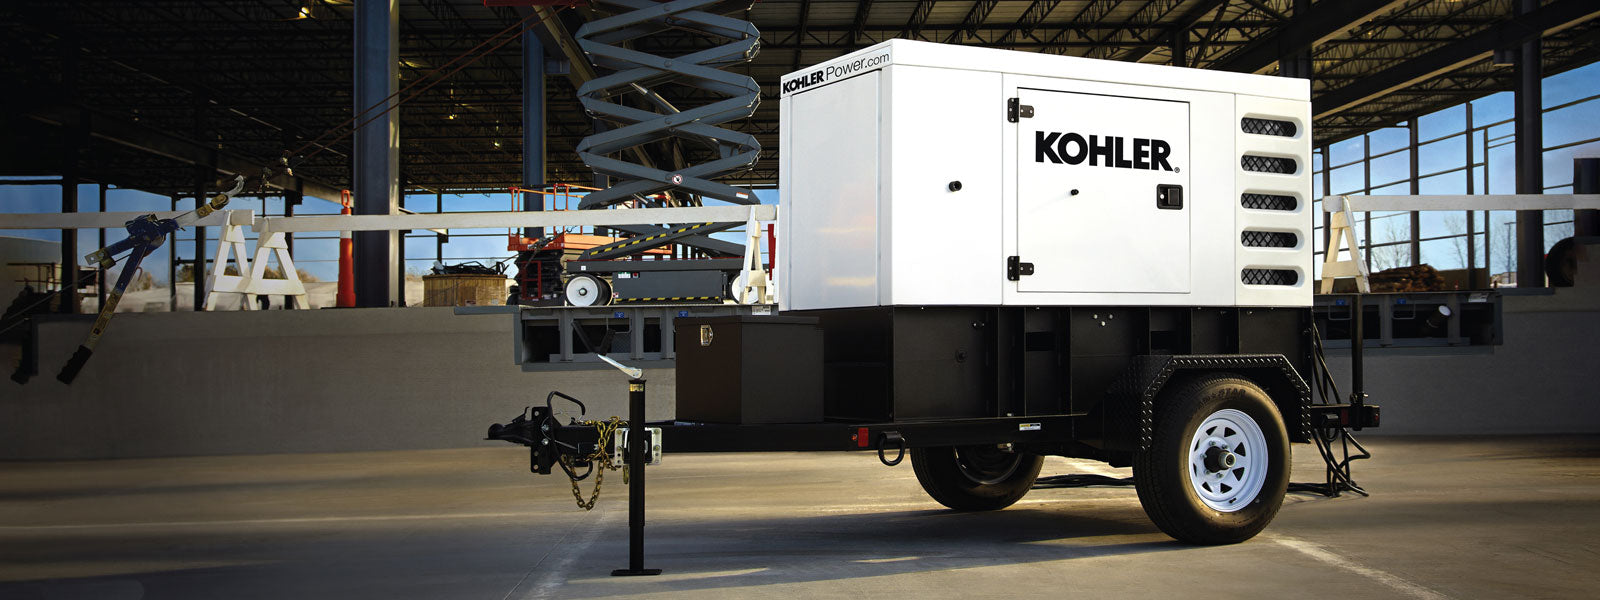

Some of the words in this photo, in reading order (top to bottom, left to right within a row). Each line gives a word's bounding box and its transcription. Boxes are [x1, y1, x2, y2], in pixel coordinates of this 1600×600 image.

[782, 70, 825, 94] KOHLER
[826, 53, 890, 80] Power.com
[1035, 130, 1174, 172] KOHLER
